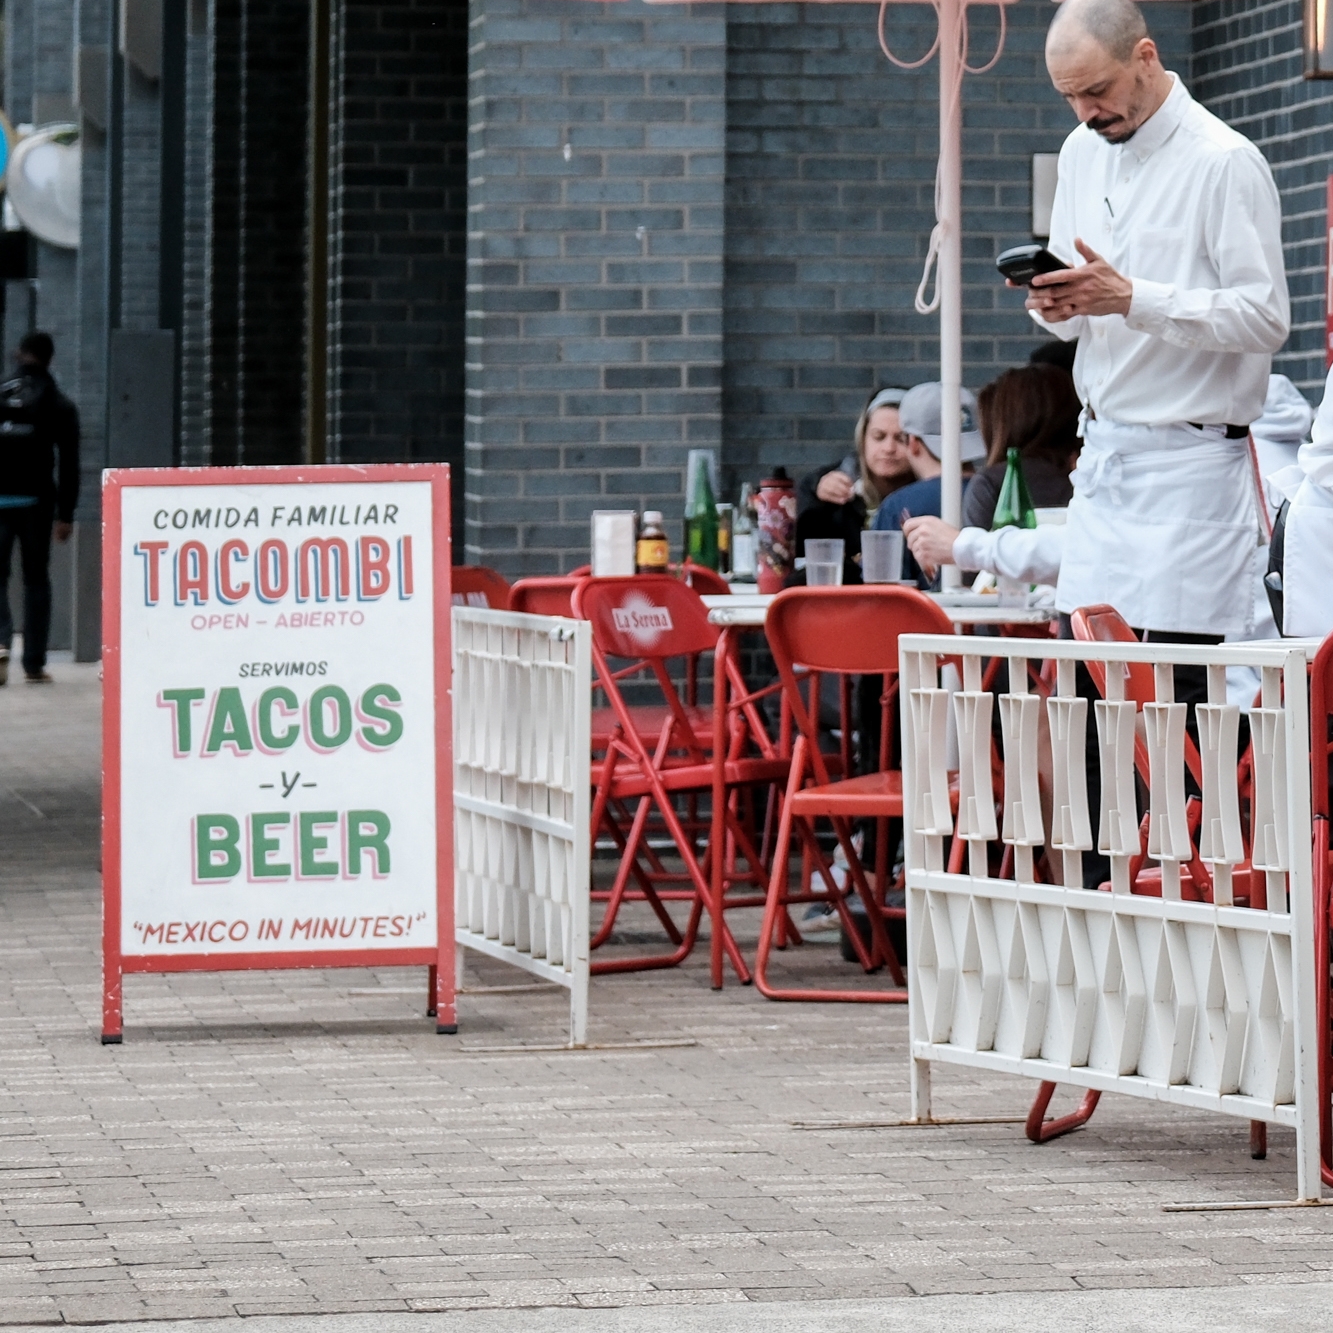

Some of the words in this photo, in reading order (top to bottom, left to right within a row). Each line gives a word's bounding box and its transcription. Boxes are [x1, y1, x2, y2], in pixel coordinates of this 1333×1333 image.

[153, 507, 261, 530] COMIDA
[270, 503, 400, 528] FAMILIAR
[134, 534, 415, 607] TACOMBI
[191, 612, 250, 631] OPEN
[274, 609, 365, 630] ABIERTO
[616, 612, 631, 628] La
[239, 661, 328, 678] SERVIMOS
[156, 682, 405, 759] TACOS
[190, 809, 392, 885] BEER
[258, 918, 282, 940] IN
